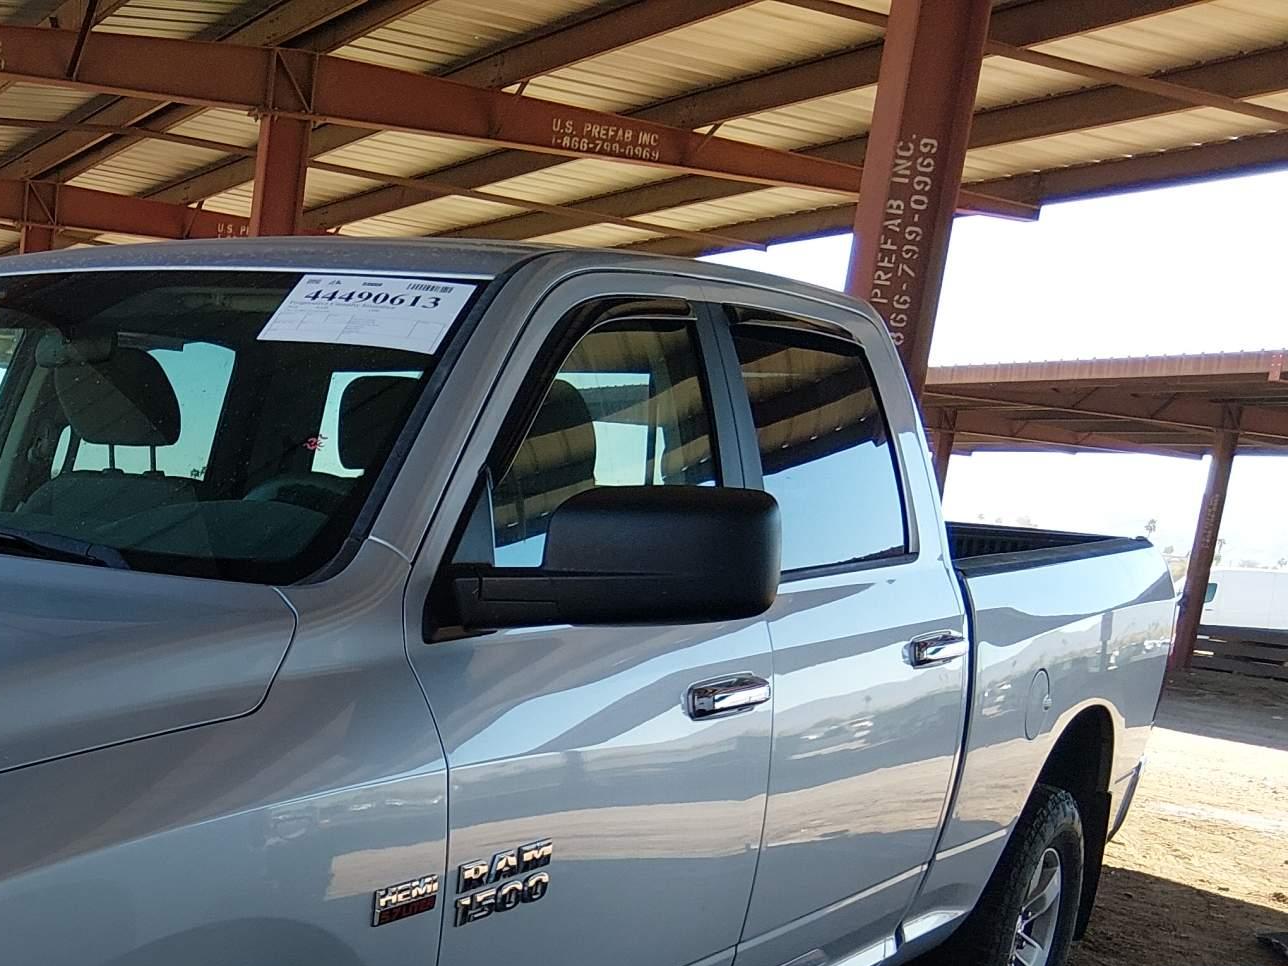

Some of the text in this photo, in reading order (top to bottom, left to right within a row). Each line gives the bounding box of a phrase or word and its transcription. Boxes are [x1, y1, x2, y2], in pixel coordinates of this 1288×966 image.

[552, 118, 659, 146] U.S. PREFAB INC
[870, 133, 917, 304] PREFAB INC.
[304, 288, 442, 310] 44490613
[456, 838, 553, 894] RAM
[376, 875, 439, 908] HEMI
[454, 872, 550, 927] 1500
